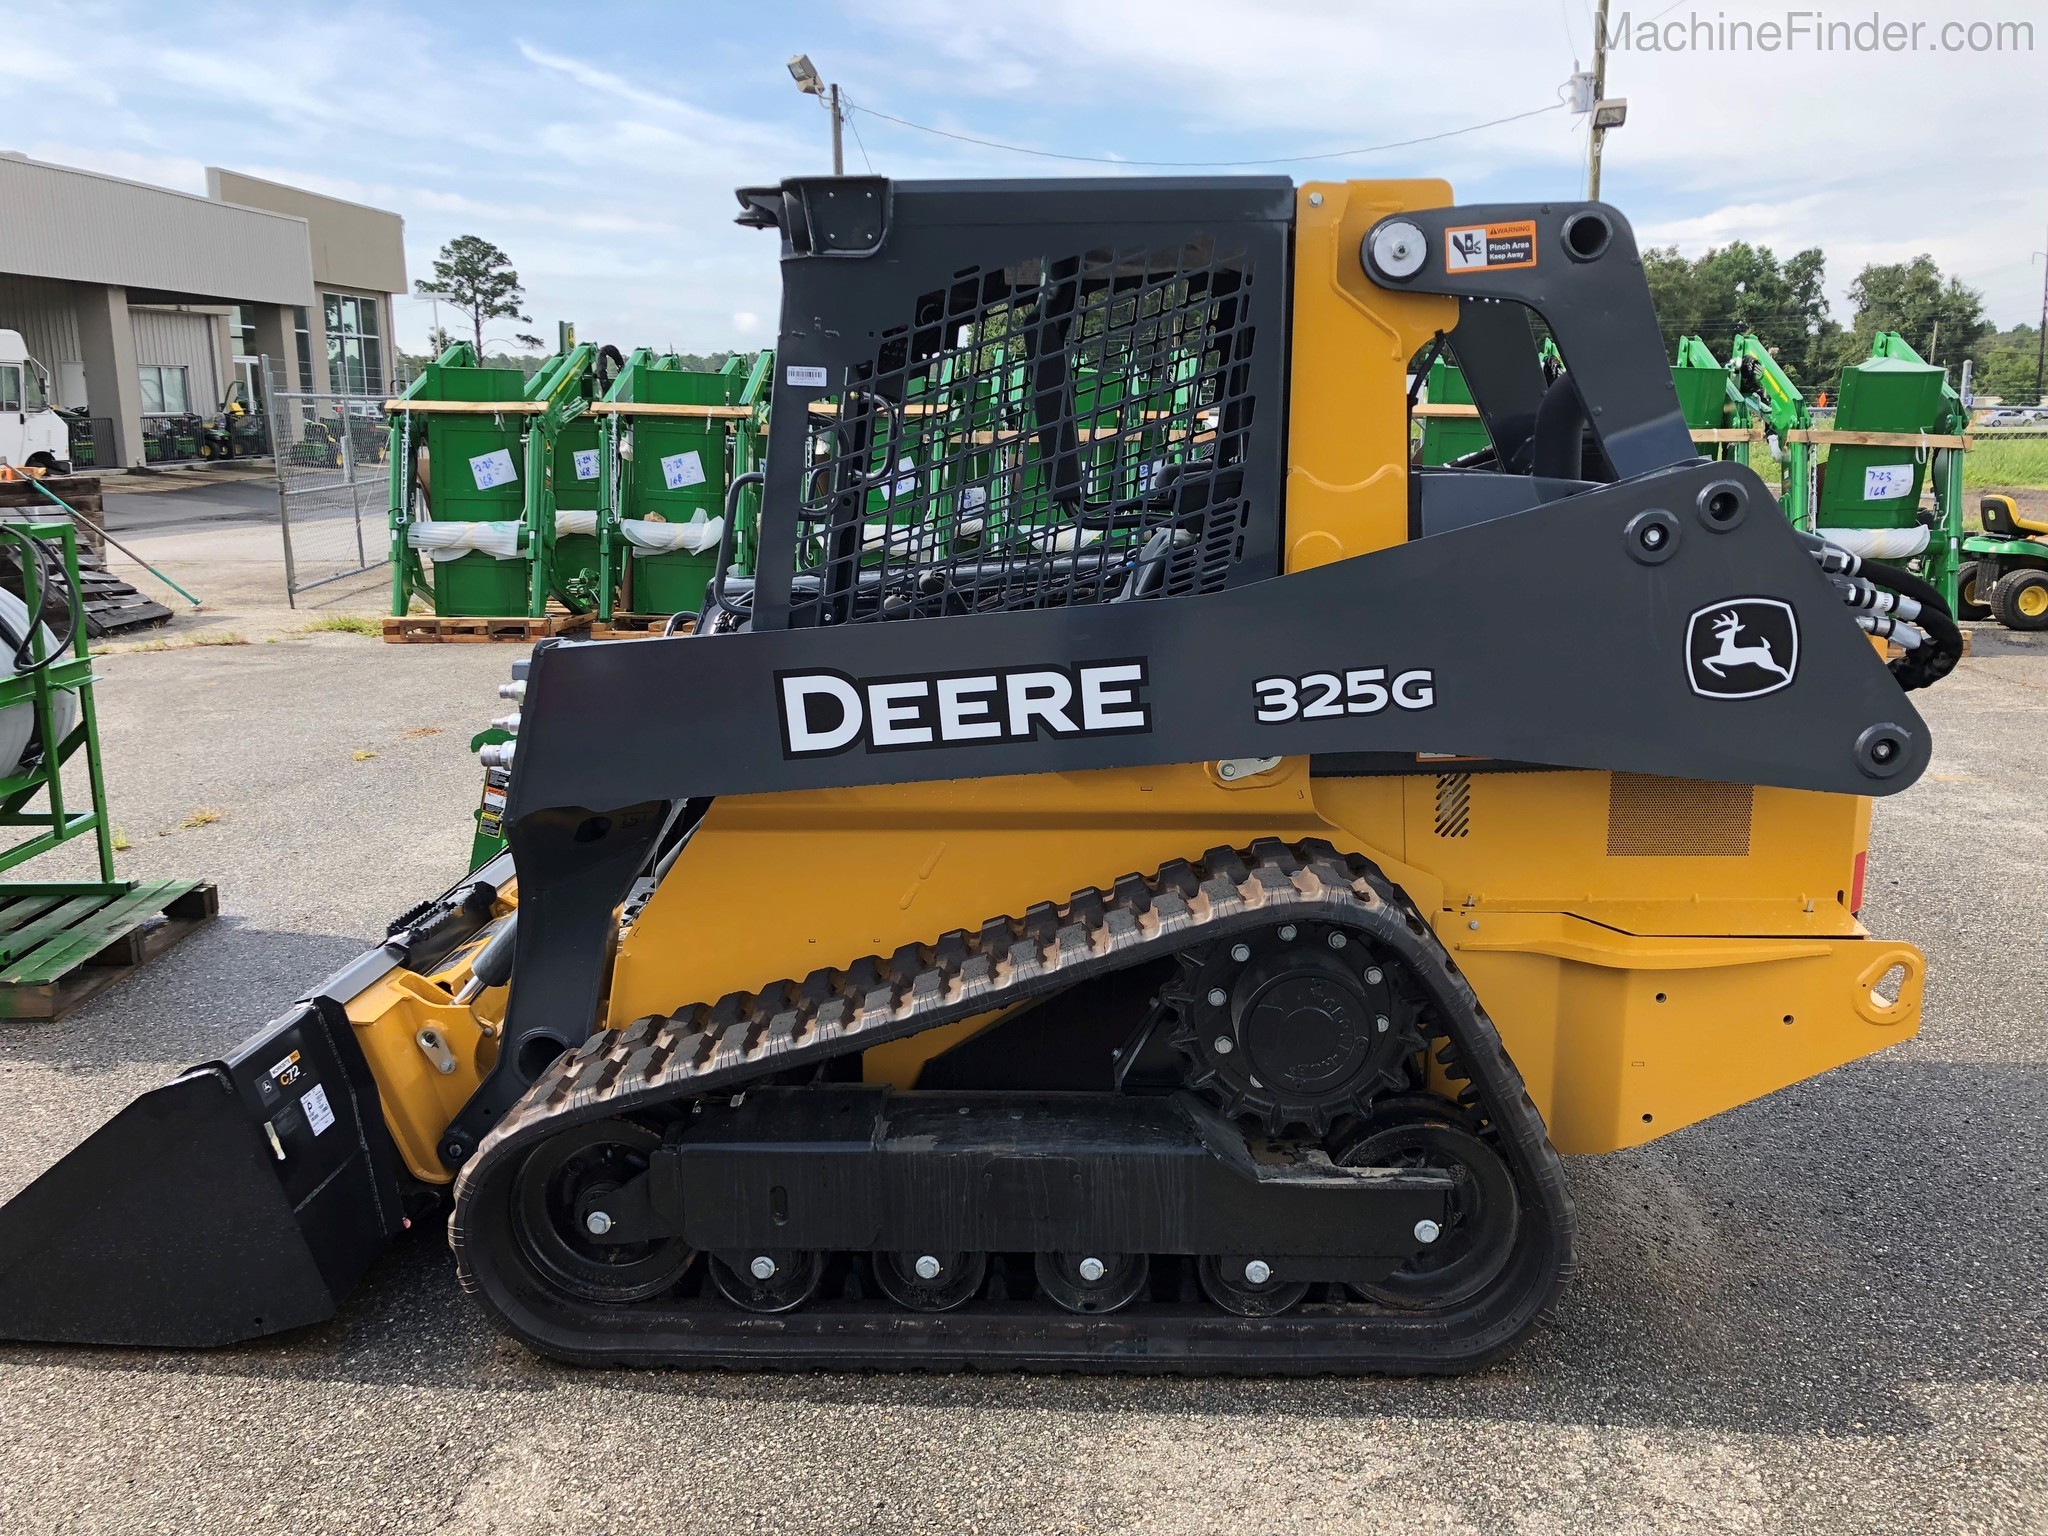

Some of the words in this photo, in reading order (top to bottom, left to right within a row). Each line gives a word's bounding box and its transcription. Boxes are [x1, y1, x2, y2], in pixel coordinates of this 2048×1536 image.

[1497, 224, 1531, 235] WARNING
[1489, 243, 1511, 252] Pinch
[1511, 241, 1530, 250] Area
[1489, 253, 1506, 261] Keep
[479, 473, 495, 487] 168
[1868, 470, 1892, 483] 7-23
[1869, 485, 1888, 496] 168
[1255, 668, 1434, 723] 325G
[781, 663, 1146, 753] DEERE
[279, 1064, 301, 1086] C72
